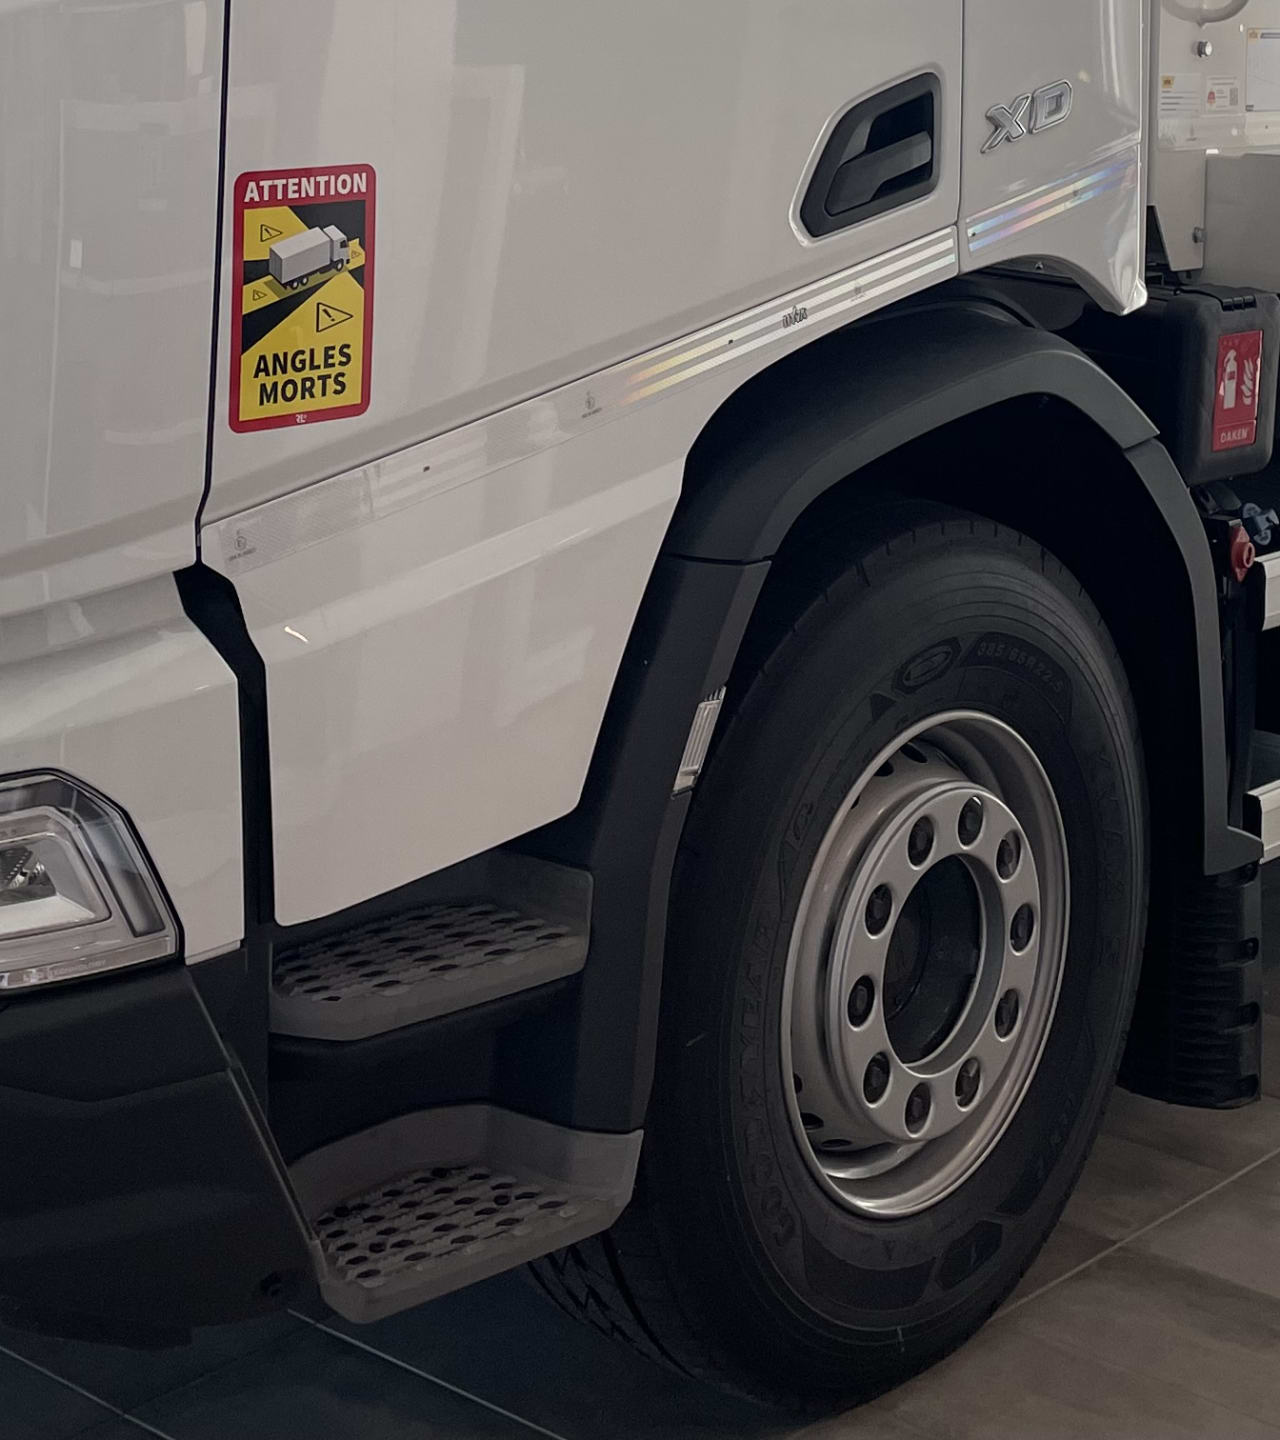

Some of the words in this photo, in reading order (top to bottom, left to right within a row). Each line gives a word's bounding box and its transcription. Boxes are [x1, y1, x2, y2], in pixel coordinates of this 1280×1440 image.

[980, 78, 1073, 154] XD
[243, 171, 367, 203] ATTENTION
[253, 343, 352, 379] ANGLES
[258, 371, 347, 407] MORTS
